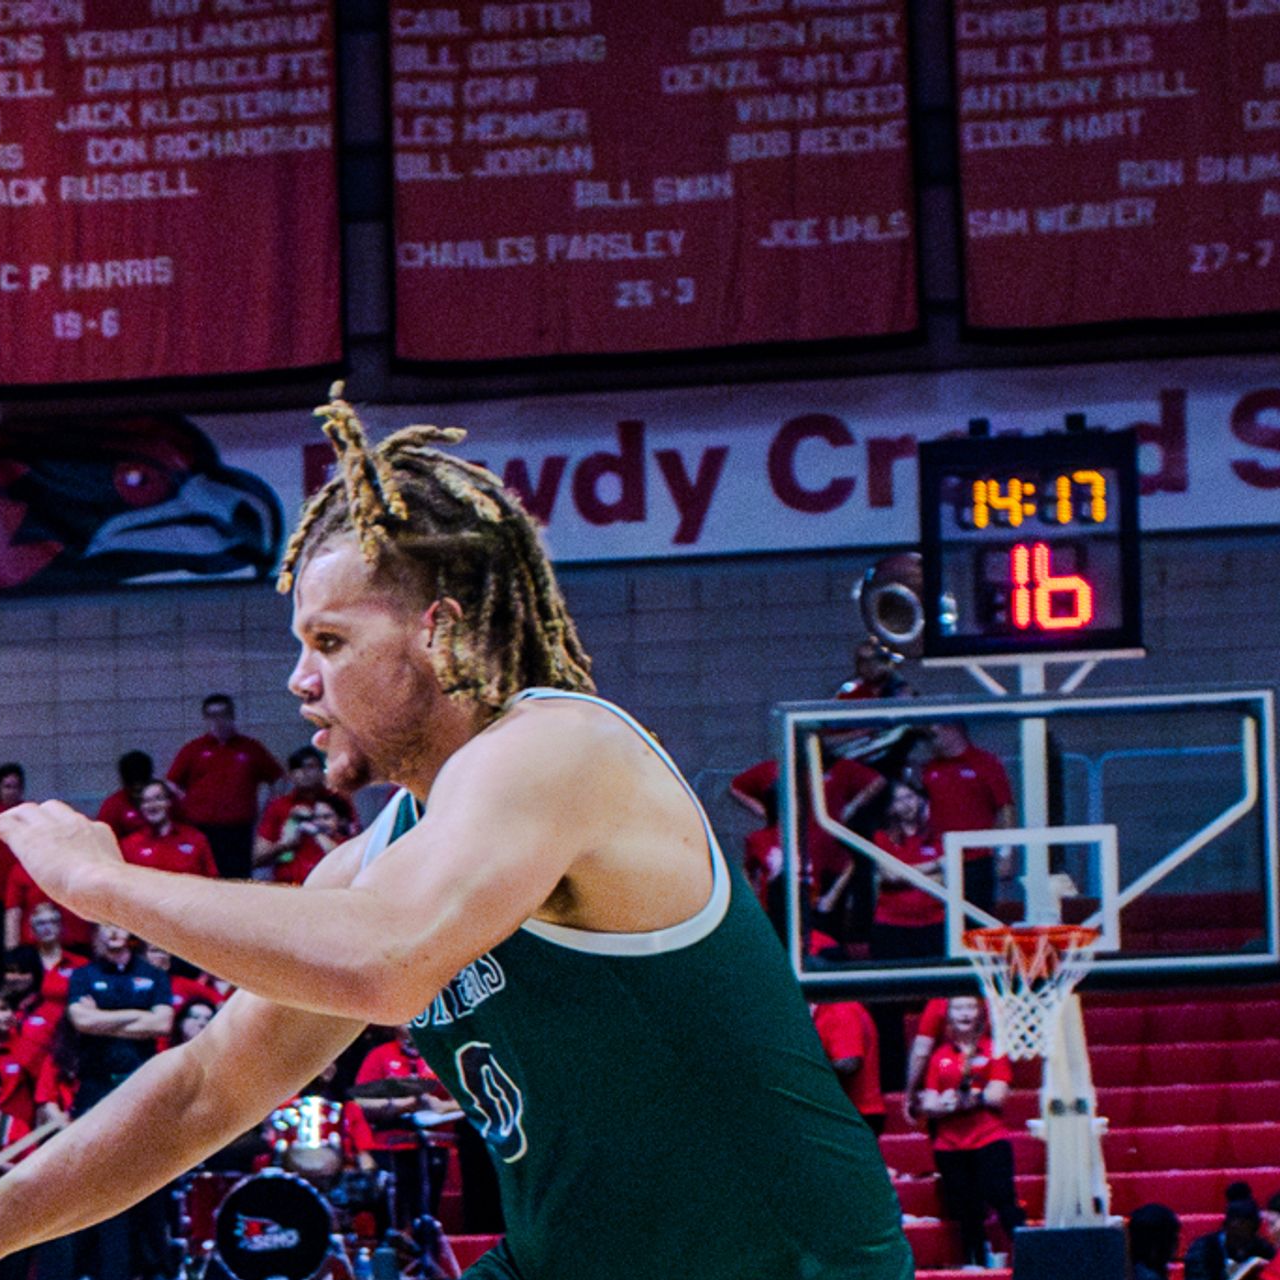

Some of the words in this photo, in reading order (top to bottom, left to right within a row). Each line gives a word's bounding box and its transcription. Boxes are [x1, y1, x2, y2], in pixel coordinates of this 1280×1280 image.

[56, 102, 132, 132] JACK
[1063, 107, 1146, 144] HART
[87, 136, 147, 166] DON
[60, 169, 199, 201] RUSSELL
[546, 228, 687, 264] PARSLEY
[0, 263, 20, 292] C
[30, 263, 51, 291] P
[62, 257, 175, 290] HARRIS
[766, 388, 1188, 514] Crd
[972, 469, 1107, 529] 14:17
[1010, 543, 1094, 630] 16
